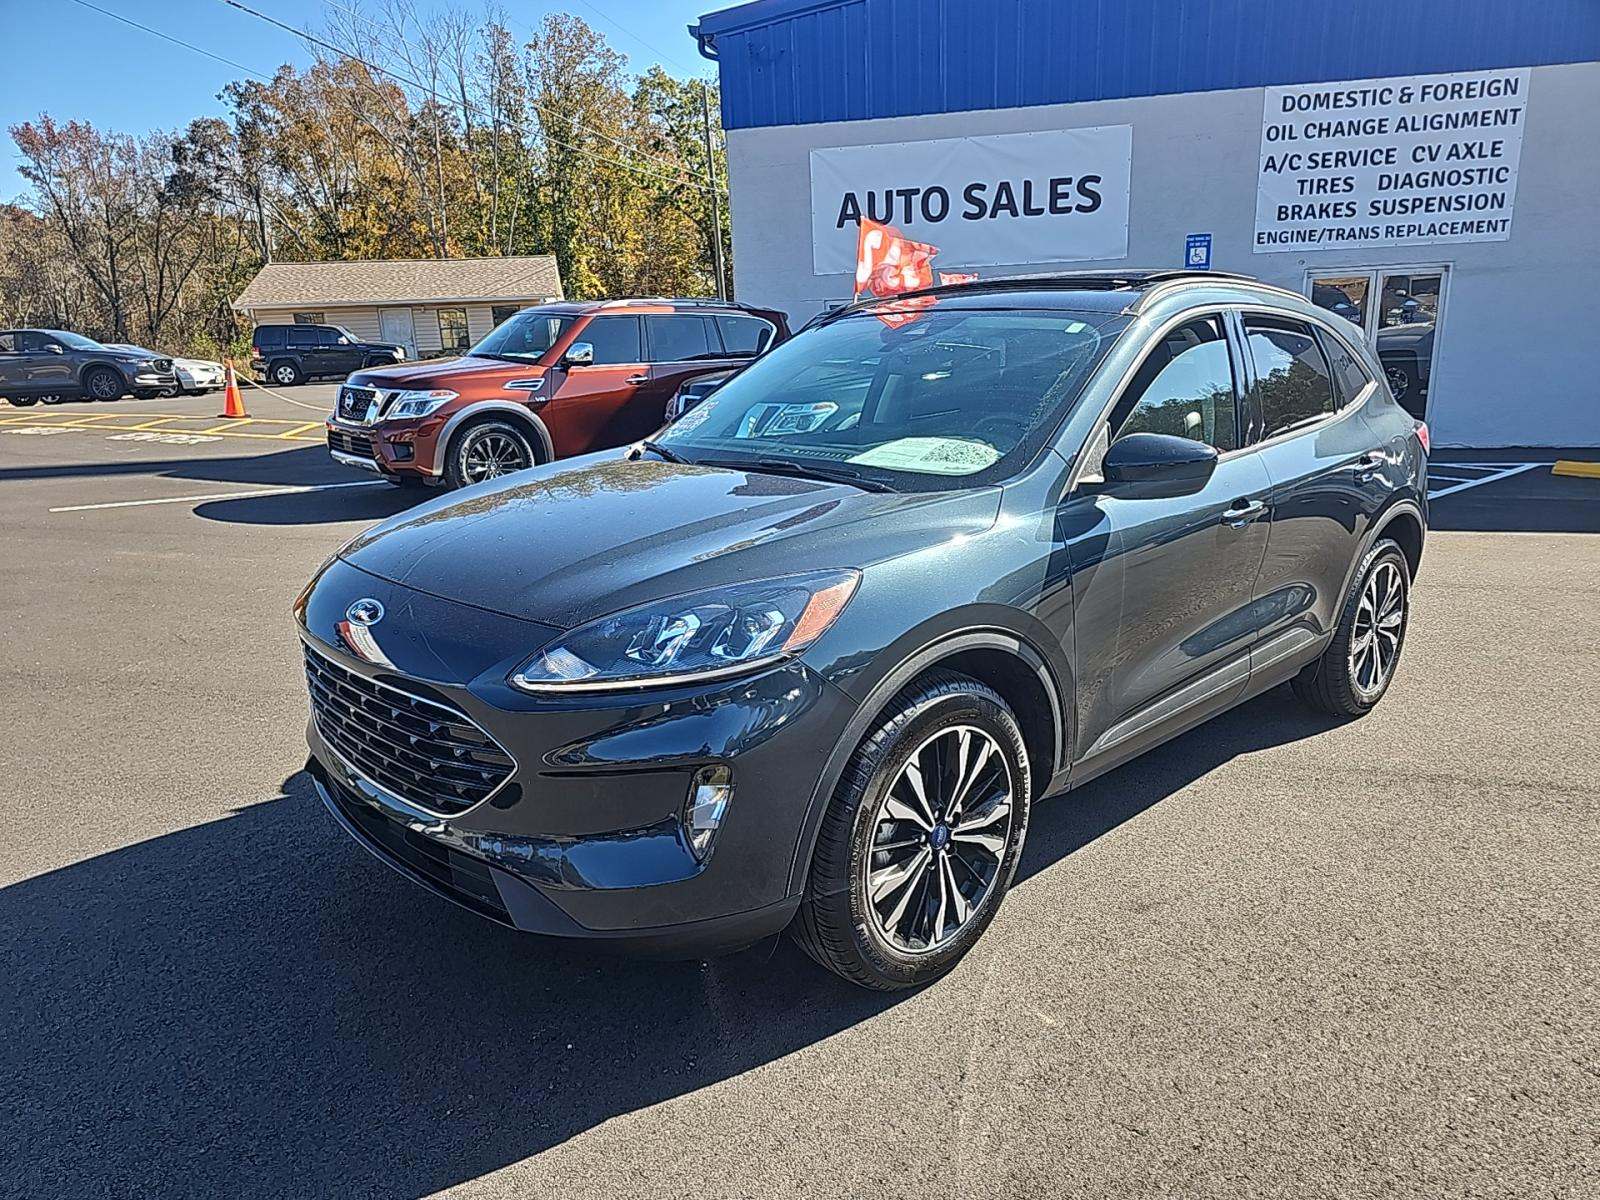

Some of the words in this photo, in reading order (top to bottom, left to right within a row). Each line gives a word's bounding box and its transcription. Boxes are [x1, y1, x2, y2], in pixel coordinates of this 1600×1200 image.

[1281, 87, 1393, 113] DOMESTIC
[1398, 86, 1414, 104] &
[1420, 77, 1519, 102] FOREIGN
[1266, 124, 1298, 141] OIL
[1303, 117, 1390, 139] CHANGE
[1394, 107, 1522, 133] ALIGNMENT
[1263, 152, 1302, 174] A/C
[1306, 147, 1397, 170] SERVICE
[1411, 144, 1442, 163] CV
[1446, 140, 1504, 161] AXLE
[1296, 176, 1355, 195] TIRES
[1377, 166, 1510, 191] DIAGNOSTIC
[836, 186, 950, 229] AUTO
[961, 174, 1102, 220] SALES
[1276, 201, 1357, 222] BRAKES
[1368, 192, 1506, 217] SUSPENSION
[1256, 226, 1381, 245] ENGINE/TRANS
[1384, 218, 1510, 239] REPLACEMENT
[999, 711, 1027, 766] MICHELIN
[850, 836, 862, 867] TOUR
